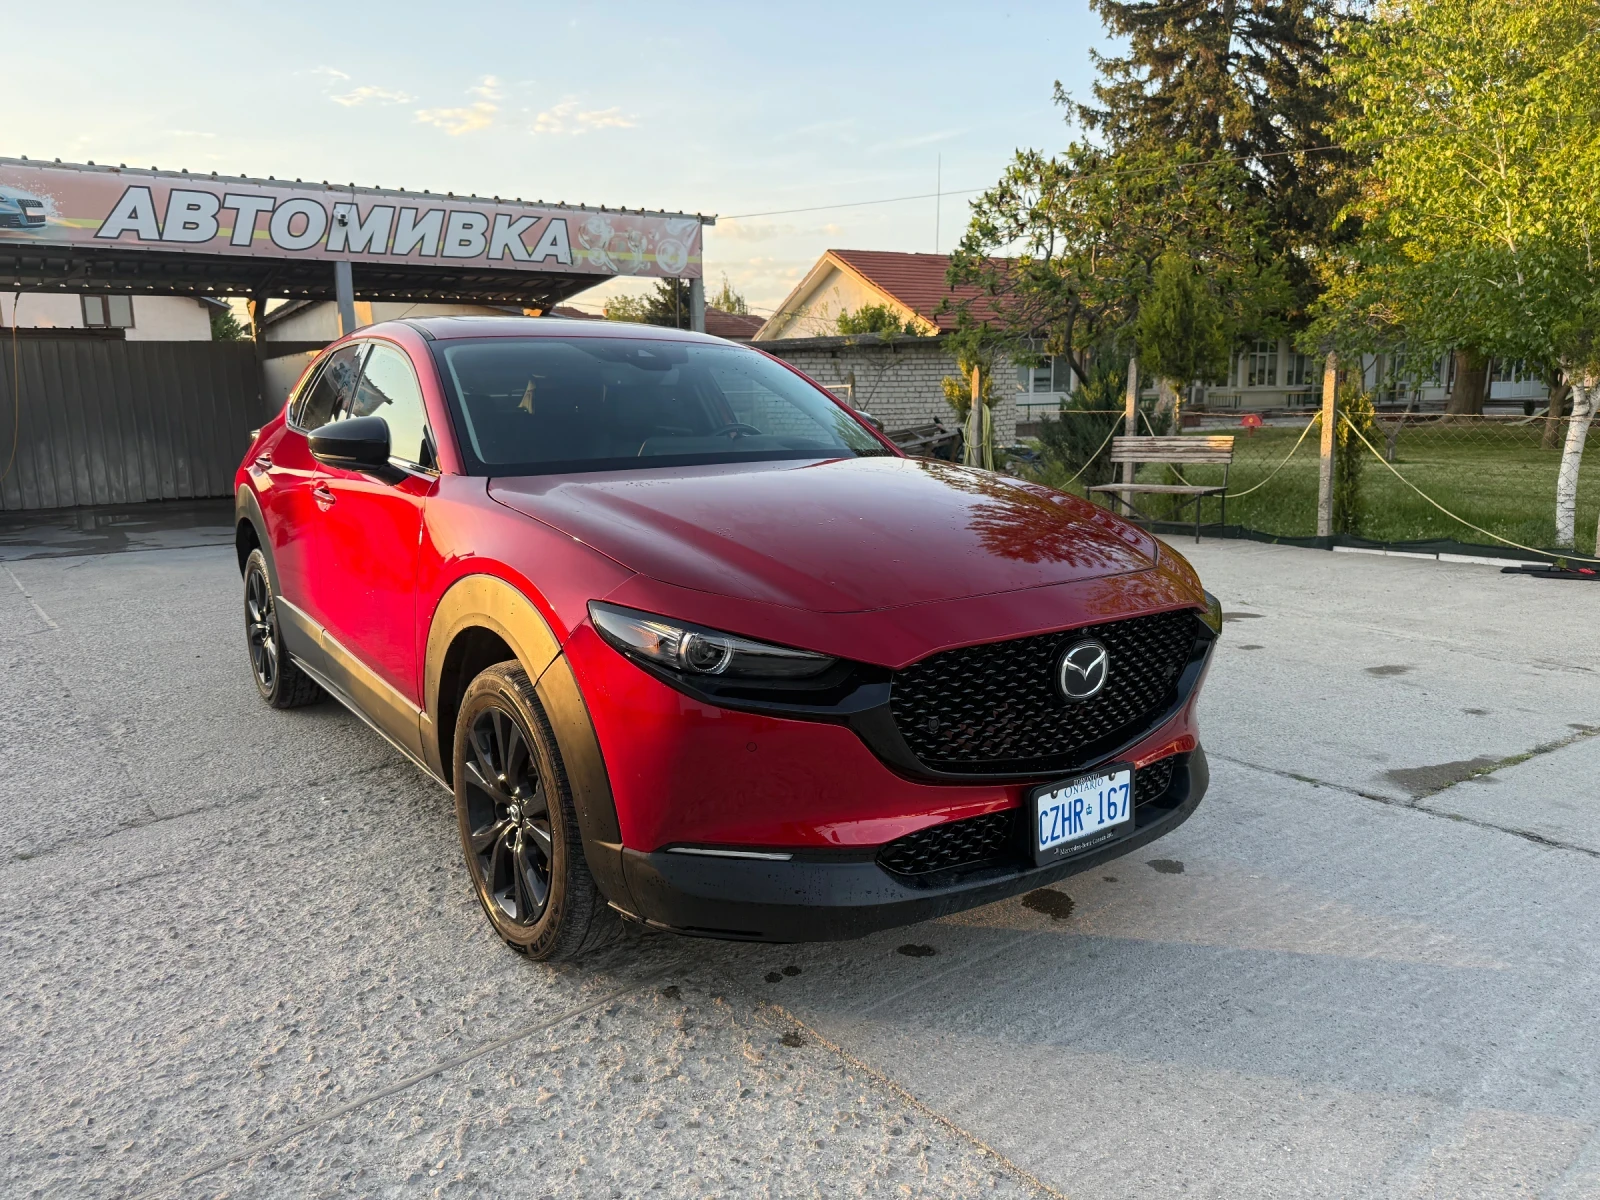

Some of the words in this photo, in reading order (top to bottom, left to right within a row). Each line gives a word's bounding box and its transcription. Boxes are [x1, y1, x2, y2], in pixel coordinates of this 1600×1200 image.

[95, 186, 573, 265] АВТОМИВКА
[1040, 798, 1084, 845] CZHR
[1098, 783, 1129, 824] 167
[1064, 778, 1103, 798] ONTARIO
